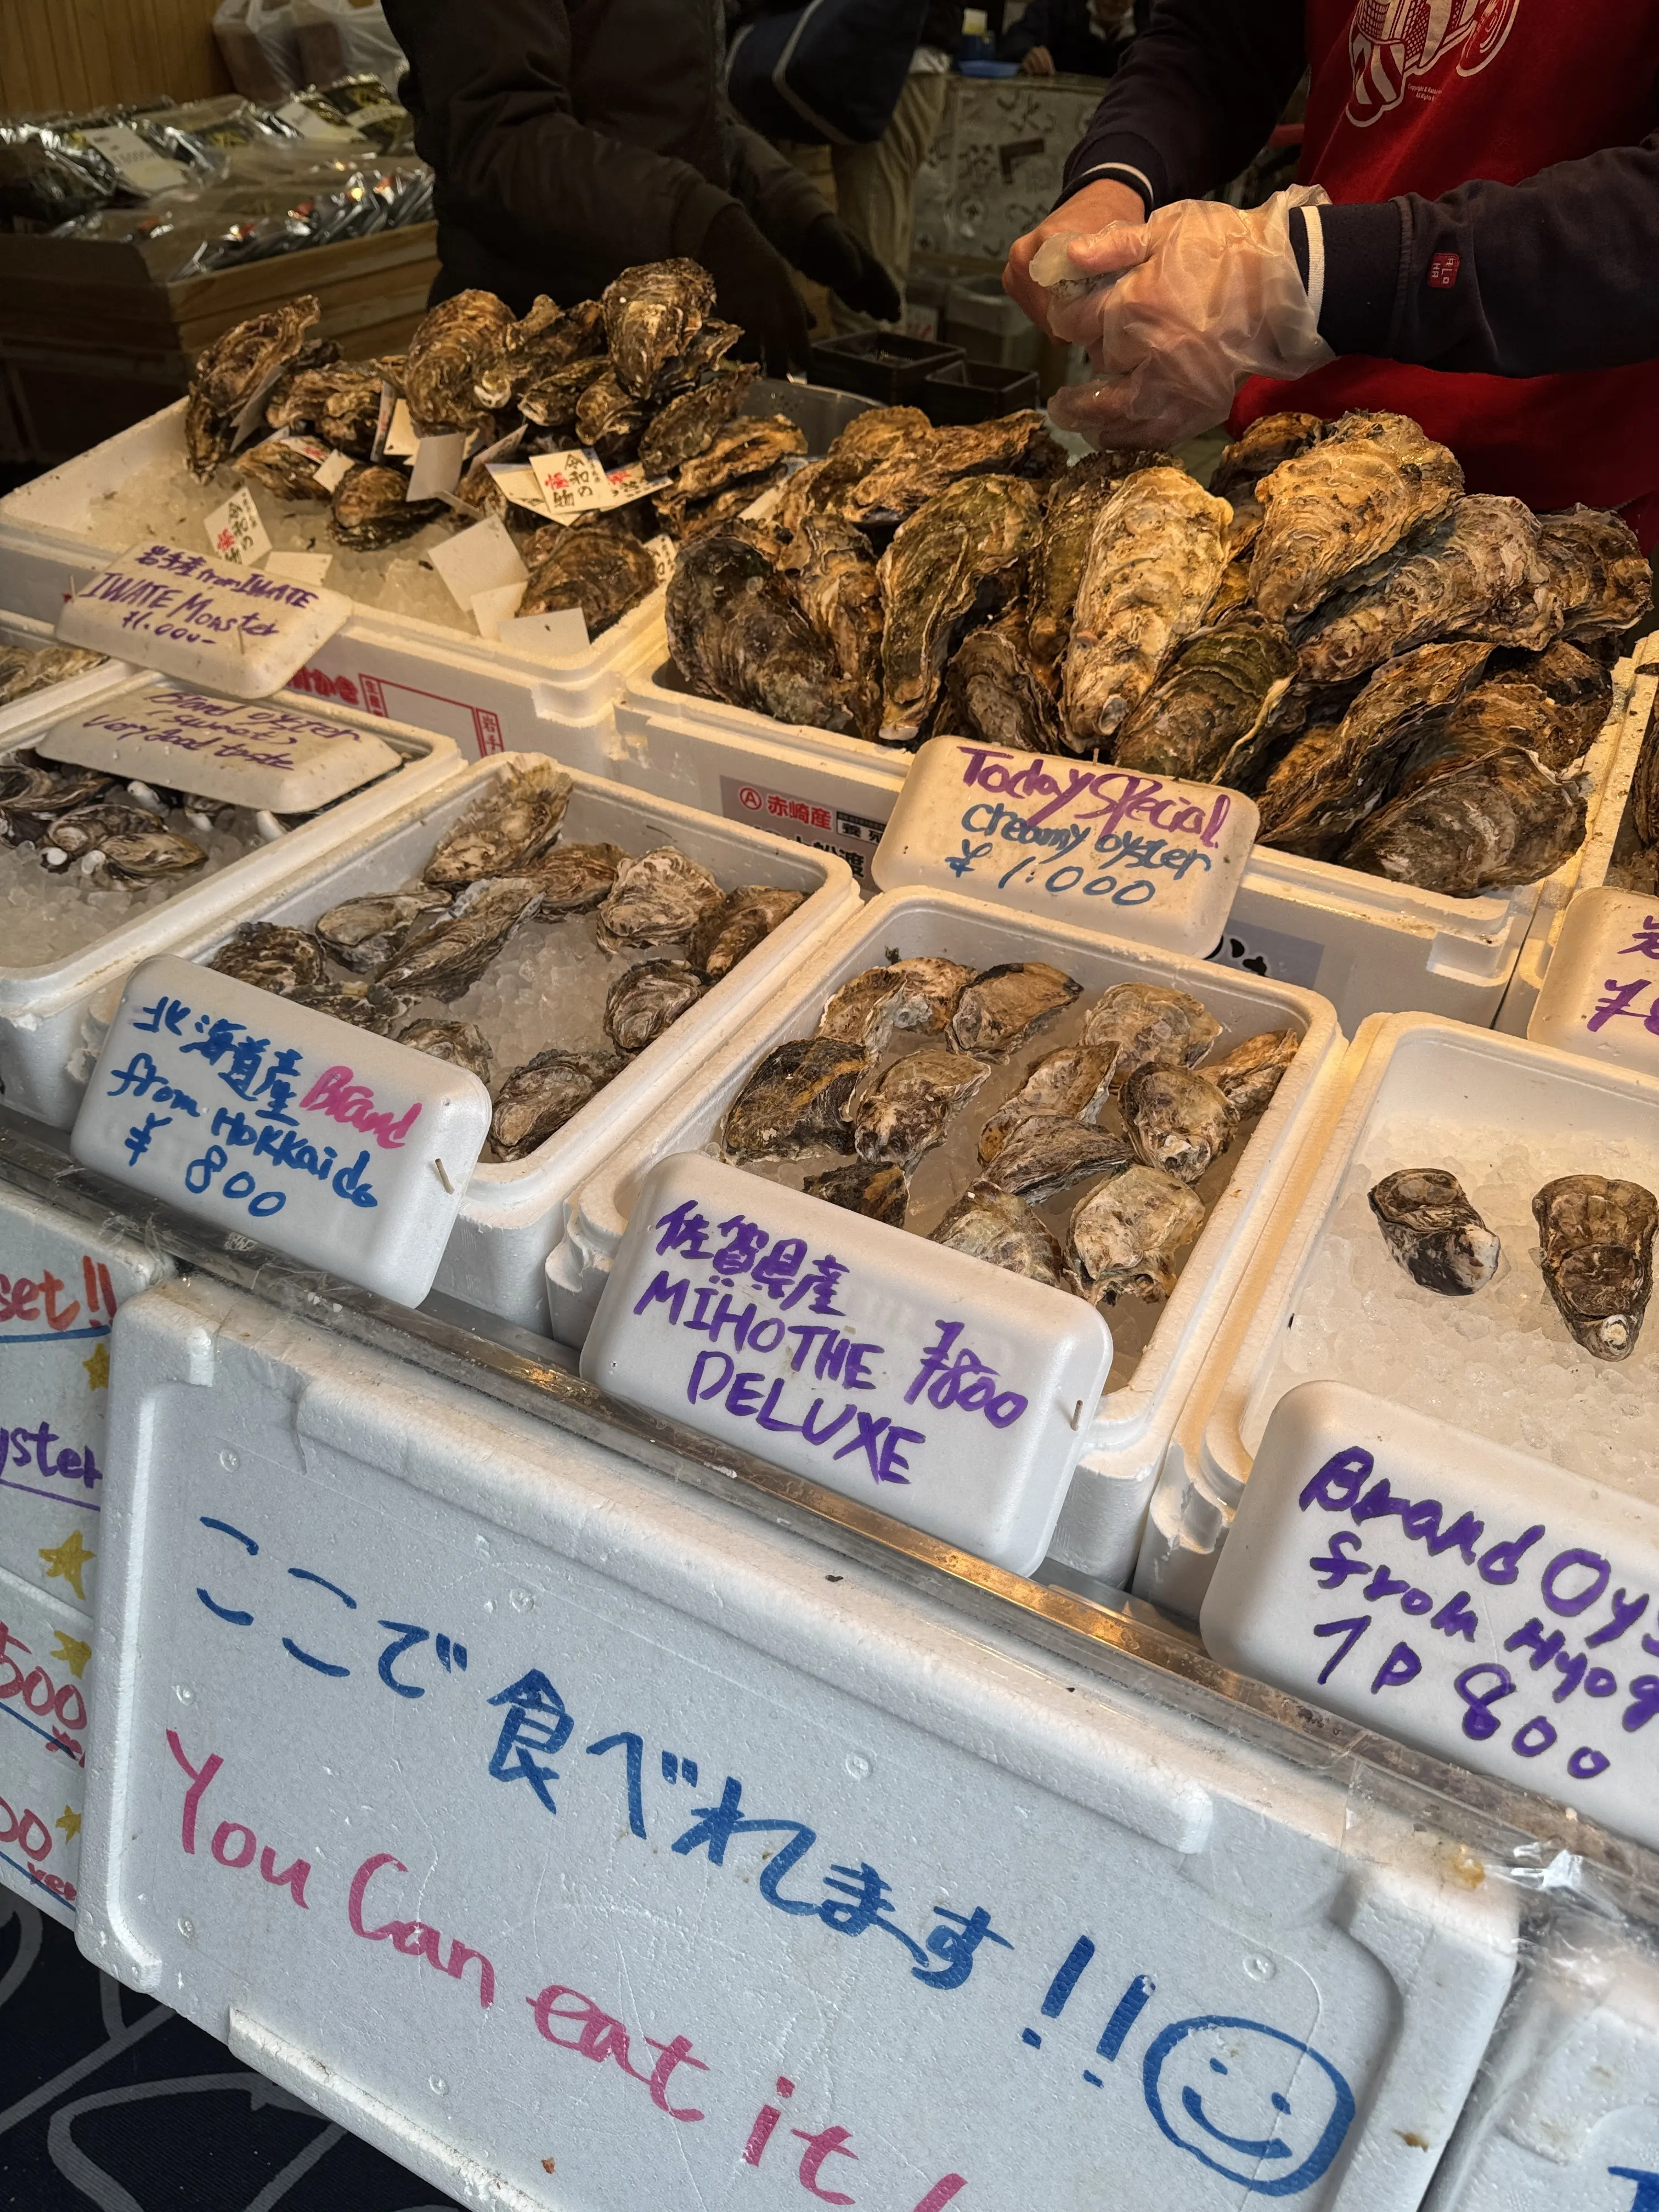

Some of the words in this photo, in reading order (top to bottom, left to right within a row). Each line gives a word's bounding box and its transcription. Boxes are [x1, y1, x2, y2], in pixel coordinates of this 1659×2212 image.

[78, 572, 183, 608] IWATE
[230, 573, 320, 609] IWATE
[957, 746, 1096, 826] Today
[107, 1052, 201, 1118] from
[133, 996, 303, 1126] 北海道産
[299, 1065, 422, 1148] Brand
[125, 1113, 172, 1166] ¥
[185, 1145, 287, 1217] 800
[656, 1199, 850, 1316] 佐賀県産
[687, 1350, 927, 1485] DELUXE
[1310, 1531, 1479, 1643] from
[1453, 1663, 1610, 1779] 800
[166, 1728, 311, 1910] You
[525, 1985, 711, 2122] eat
